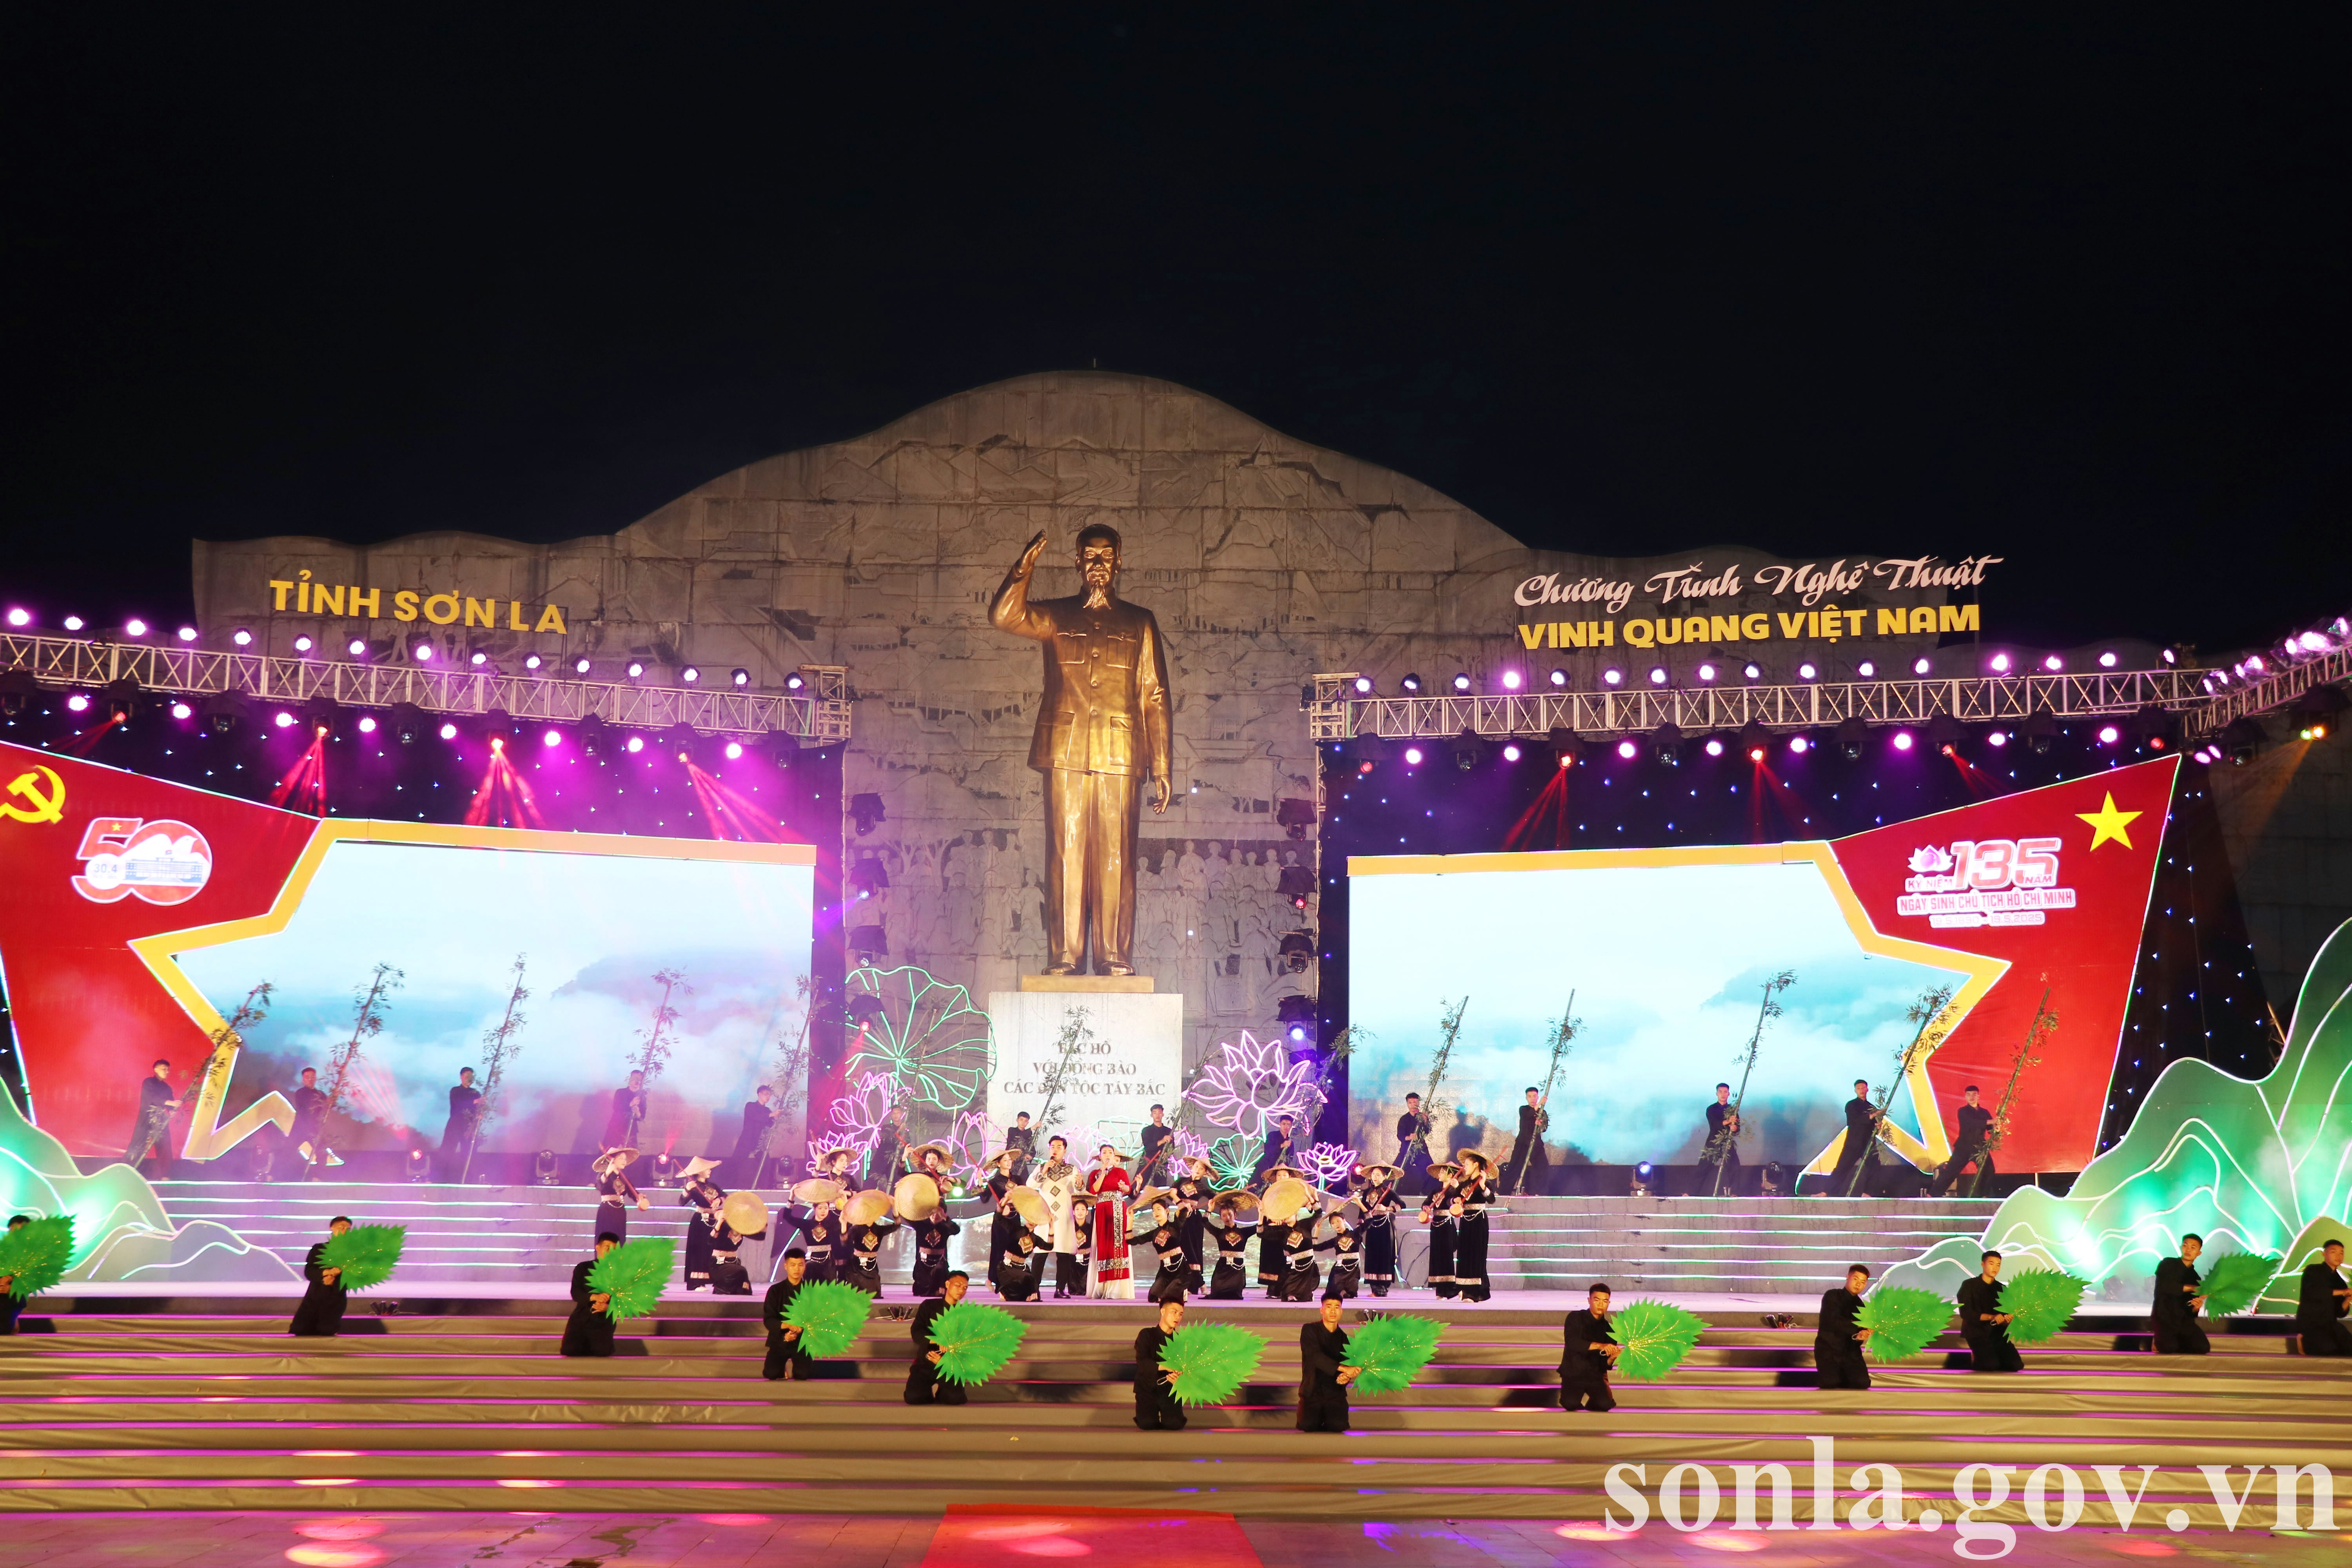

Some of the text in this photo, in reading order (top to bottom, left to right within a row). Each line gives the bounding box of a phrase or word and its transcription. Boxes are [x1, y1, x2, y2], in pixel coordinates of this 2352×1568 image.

[1514, 555, 2004, 613] Chương Trình Nghệ Thuật
[270, 570, 567, 634] TỈNH SƠN LA
[1518, 604, 1980, 650] VINH QUANG VIỆT NAM
[94, 864, 117, 873] 30.4
[1952, 839, 2060, 889] 135
[2025, 874, 2052, 884] NĂM
[1900, 890, 2072, 911] NGÀY SINH CHỦ TỊCH HỒ CHÍ MINH
[1991, 914, 2042, 923] 19.5.2025
[1091, 1038, 1111, 1054] HỒ
[1107, 1060, 1136, 1075] BÀO
[1004, 1079, 1034, 1094] CÁC
[1104, 1080, 1132, 1095] TÂY
[1136, 1079, 1165, 1095] BẮC
